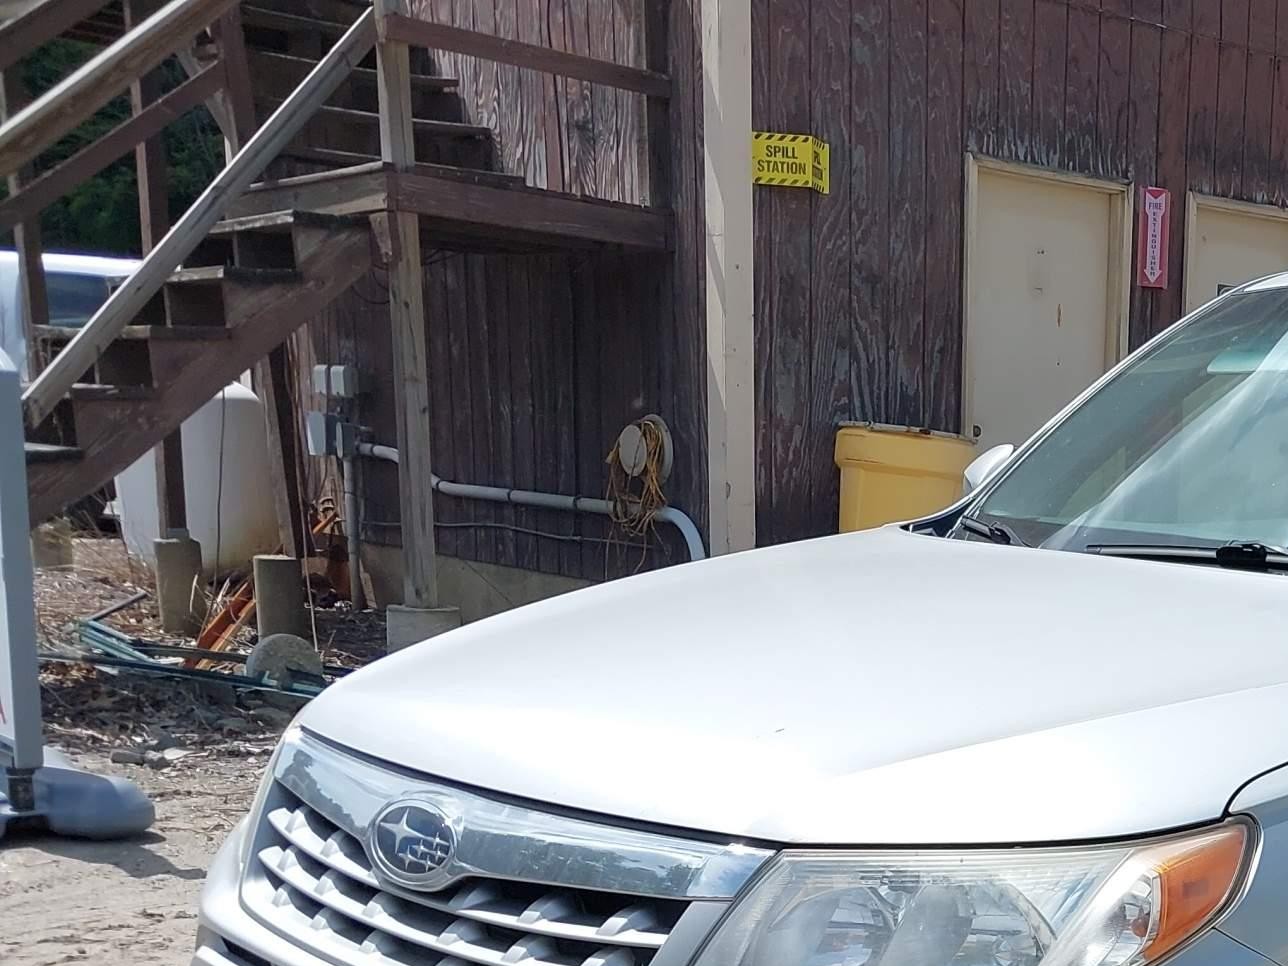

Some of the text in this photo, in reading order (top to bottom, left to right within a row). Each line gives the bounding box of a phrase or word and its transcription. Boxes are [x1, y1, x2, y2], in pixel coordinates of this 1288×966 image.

[765, 144, 798, 160] SPILL
[757, 159, 807, 175] STATION
[1148, 202, 1162, 210] FIRE
[1149, 211, 1158, 277] EXTINGUISHER
